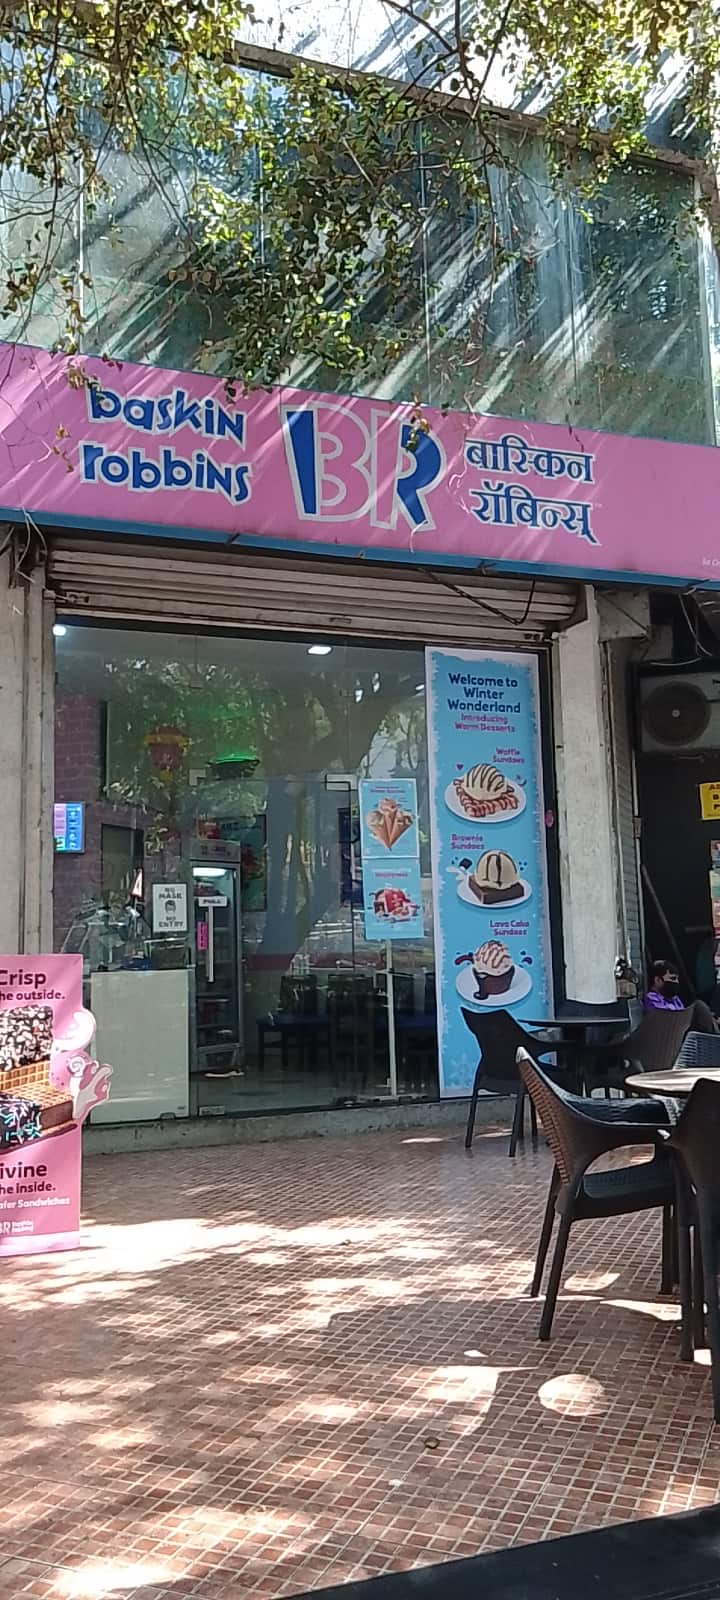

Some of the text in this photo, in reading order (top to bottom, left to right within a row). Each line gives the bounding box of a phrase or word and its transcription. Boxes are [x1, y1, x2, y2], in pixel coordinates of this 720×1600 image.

[464, 434, 594, 482] बास्किन
[80, 442, 251, 503] robbins
[279, 401, 447, 531] BR
[448, 673, 518, 688] Welcome to
[463, 686, 504, 700] Winter
[447, 698, 521, 714] Wonderland
[480, 723, 515, 733] Desserts
[158, 892, 182, 900] MASK
[0, 989, 66, 1001] he outside.
[0, 1161, 48, 1179] ivine
[0, 1180, 57, 1194] he inside.
[17, 1197, 70, 1208] Sandwiches
